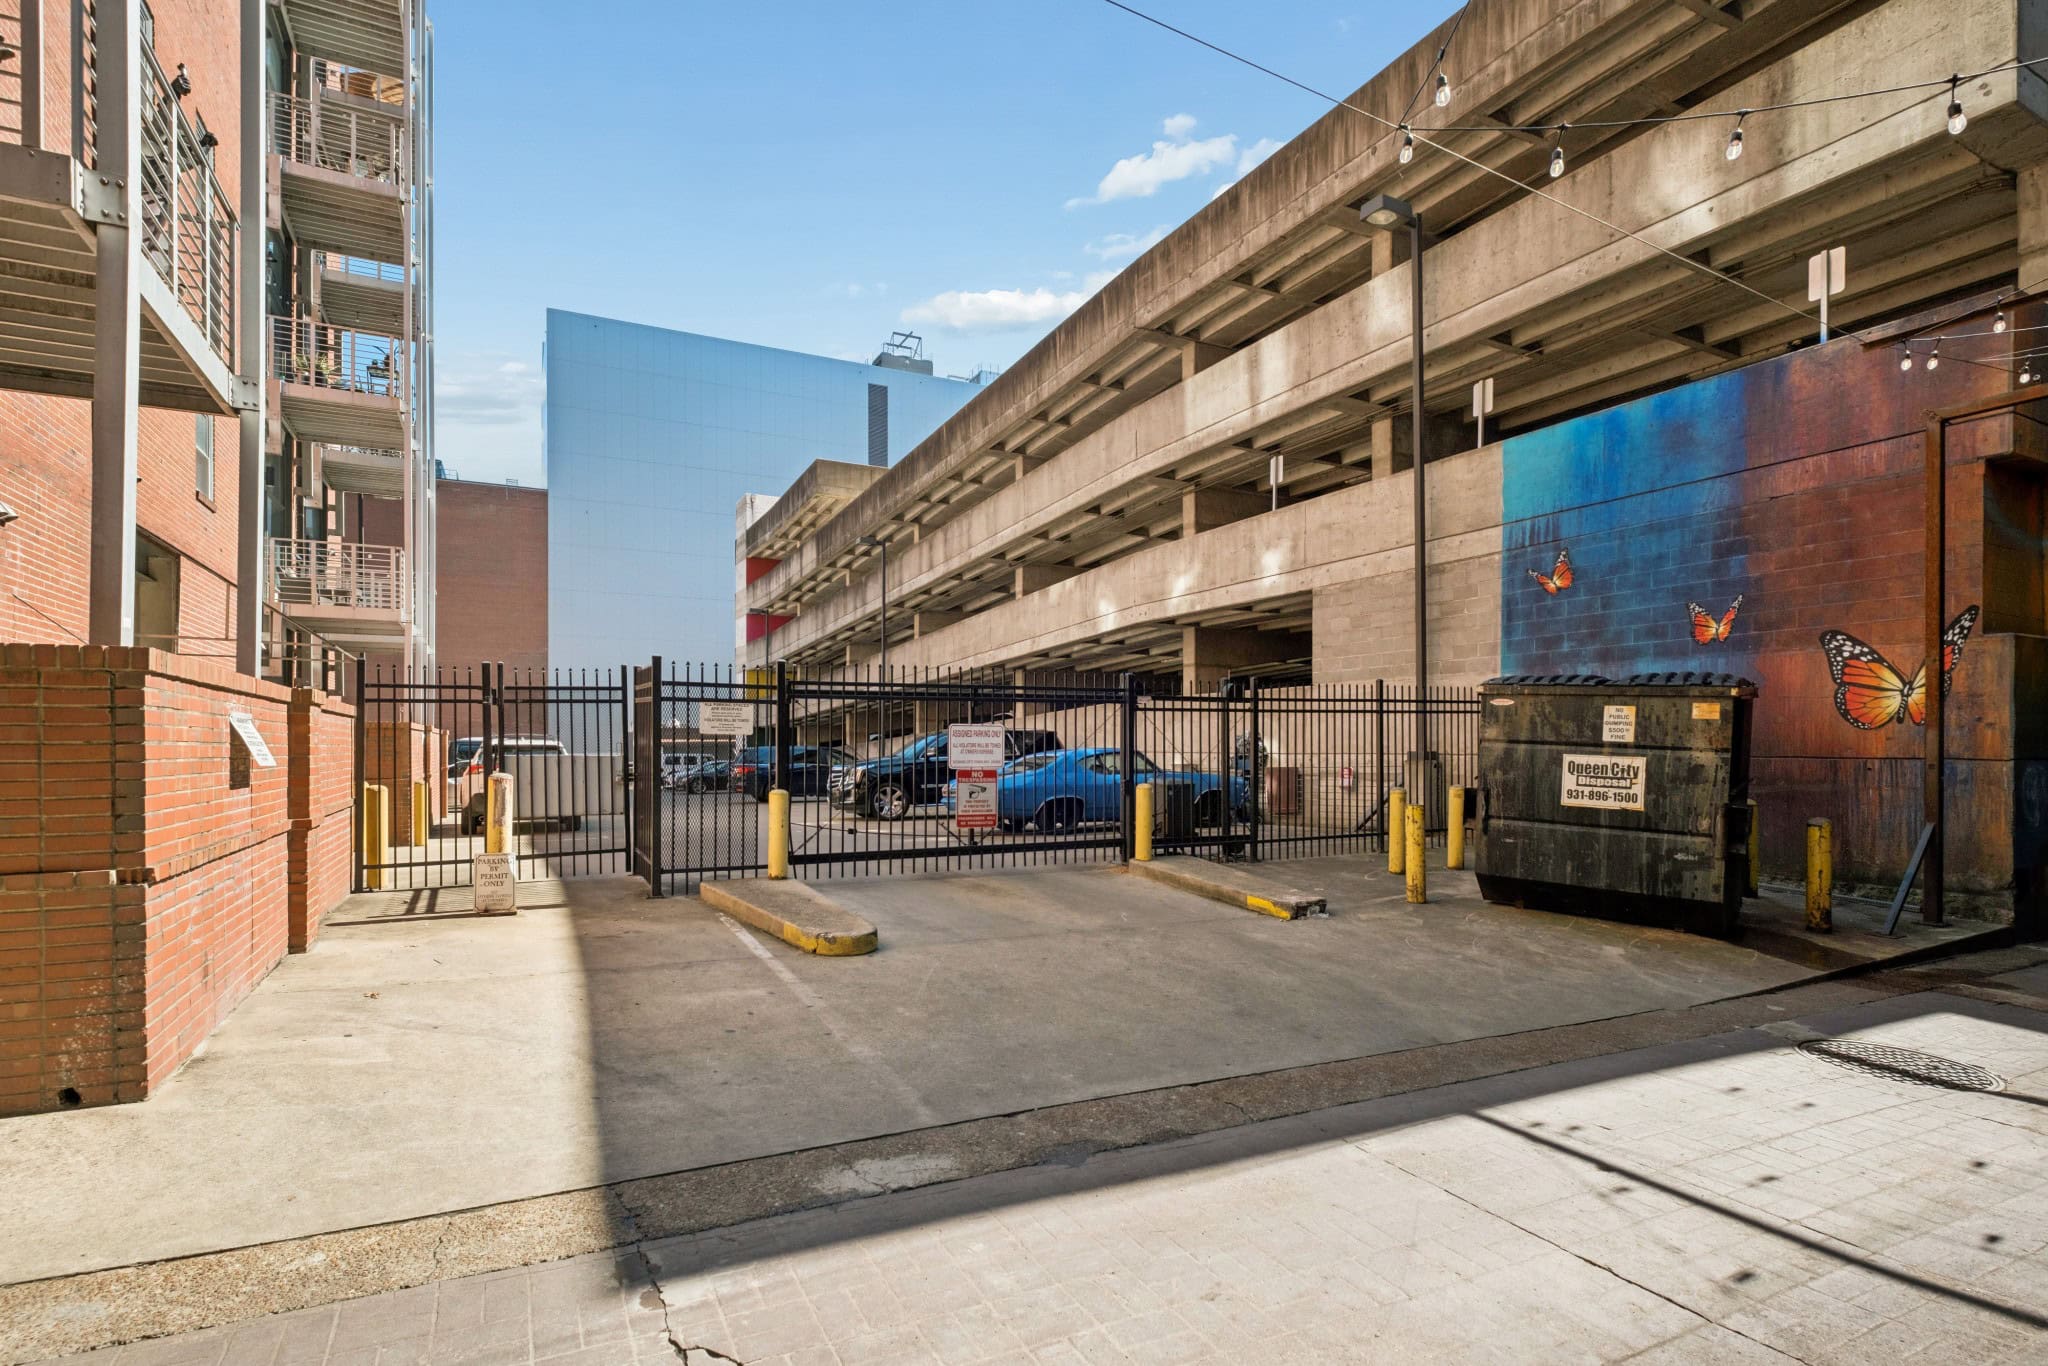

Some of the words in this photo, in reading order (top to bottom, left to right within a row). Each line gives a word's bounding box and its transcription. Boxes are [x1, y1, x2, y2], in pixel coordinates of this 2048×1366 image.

[974, 730, 990, 738] PARKING
[992, 730, 1001, 738] ONLY
[1568, 760, 1608, 776] Queen
[1612, 762, 1640, 780] City
[1578, 776, 1631, 787] Disposal
[1566, 789, 1638, 804] 931-896-1500
